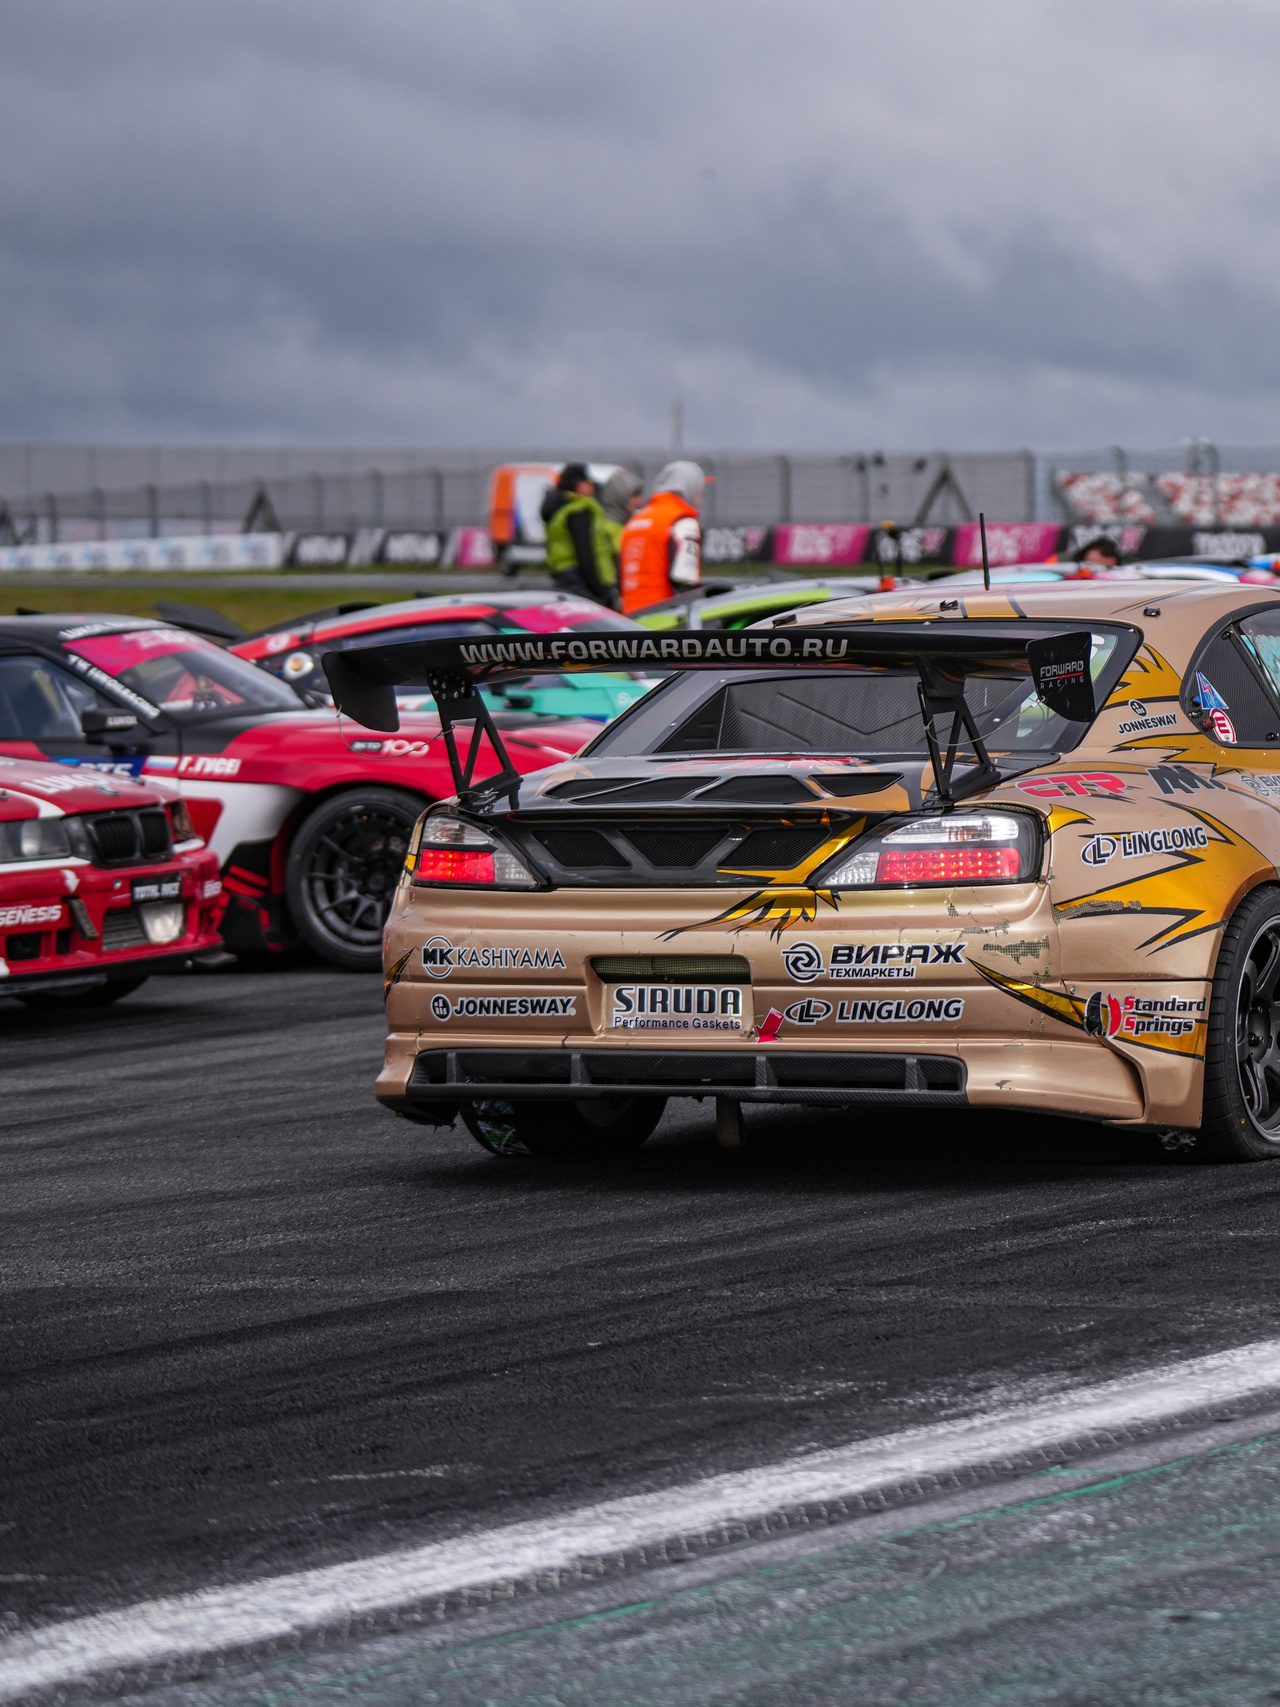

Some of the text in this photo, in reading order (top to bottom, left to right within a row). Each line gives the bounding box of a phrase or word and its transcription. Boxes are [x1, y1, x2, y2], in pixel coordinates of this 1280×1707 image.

[460, 638, 848, 664] WWW.FORWARDAUTO.RU
[1040, 660, 1084, 678] FORWARD
[1040, 678, 1084, 690] RACING
[1118, 714, 1178, 734] JONNESWAY
[1122, 827, 1208, 857] LINGLONG
[423, 948, 566, 968] MK KASHIYAMA
[831, 944, 966, 964] ВИРАЖ
[829, 968, 915, 978] ТЕХМАРКЕТЫ
[454, 998, 573, 1015] JONNESWAY
[615, 987, 741, 1014] SIRUDA
[837, 999, 963, 1021] LINGLONG
[1124, 996, 1207, 1012] Standard
[614, 1017, 741, 1030] Performance Gaskets
[1124, 1016, 1194, 1036] Springs
